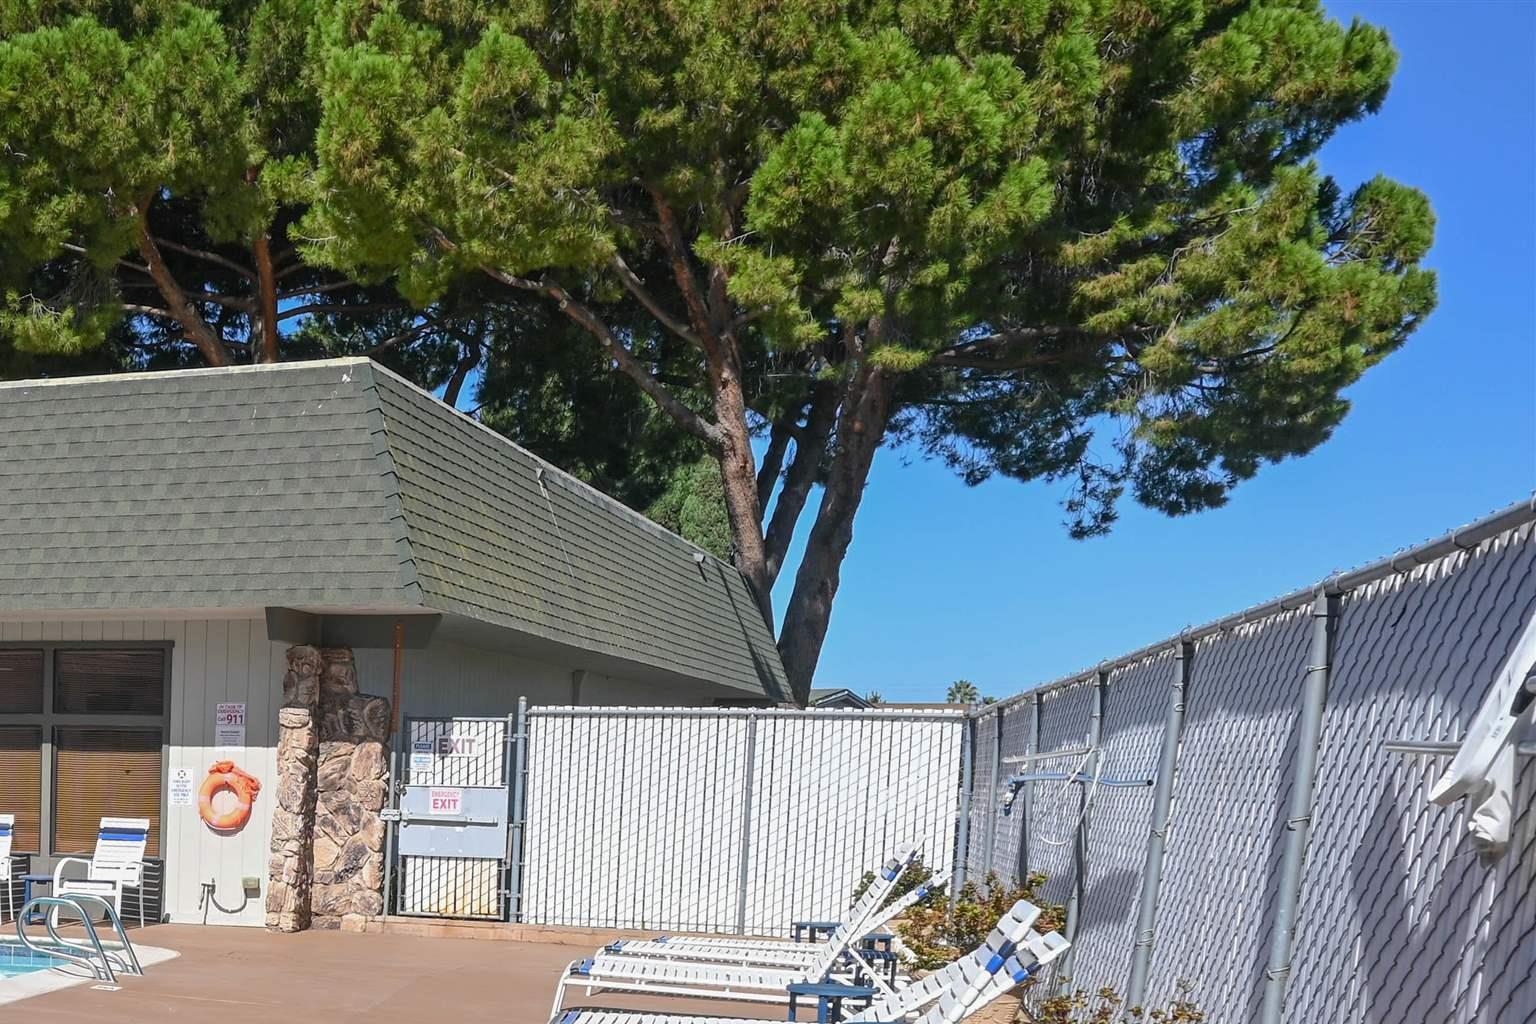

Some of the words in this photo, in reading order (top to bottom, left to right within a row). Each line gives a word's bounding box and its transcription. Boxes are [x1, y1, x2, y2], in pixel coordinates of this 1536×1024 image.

[226, 714, 243, 724] 911
[438, 738, 476, 754] EXIT
[432, 799, 458, 809] EXIT
